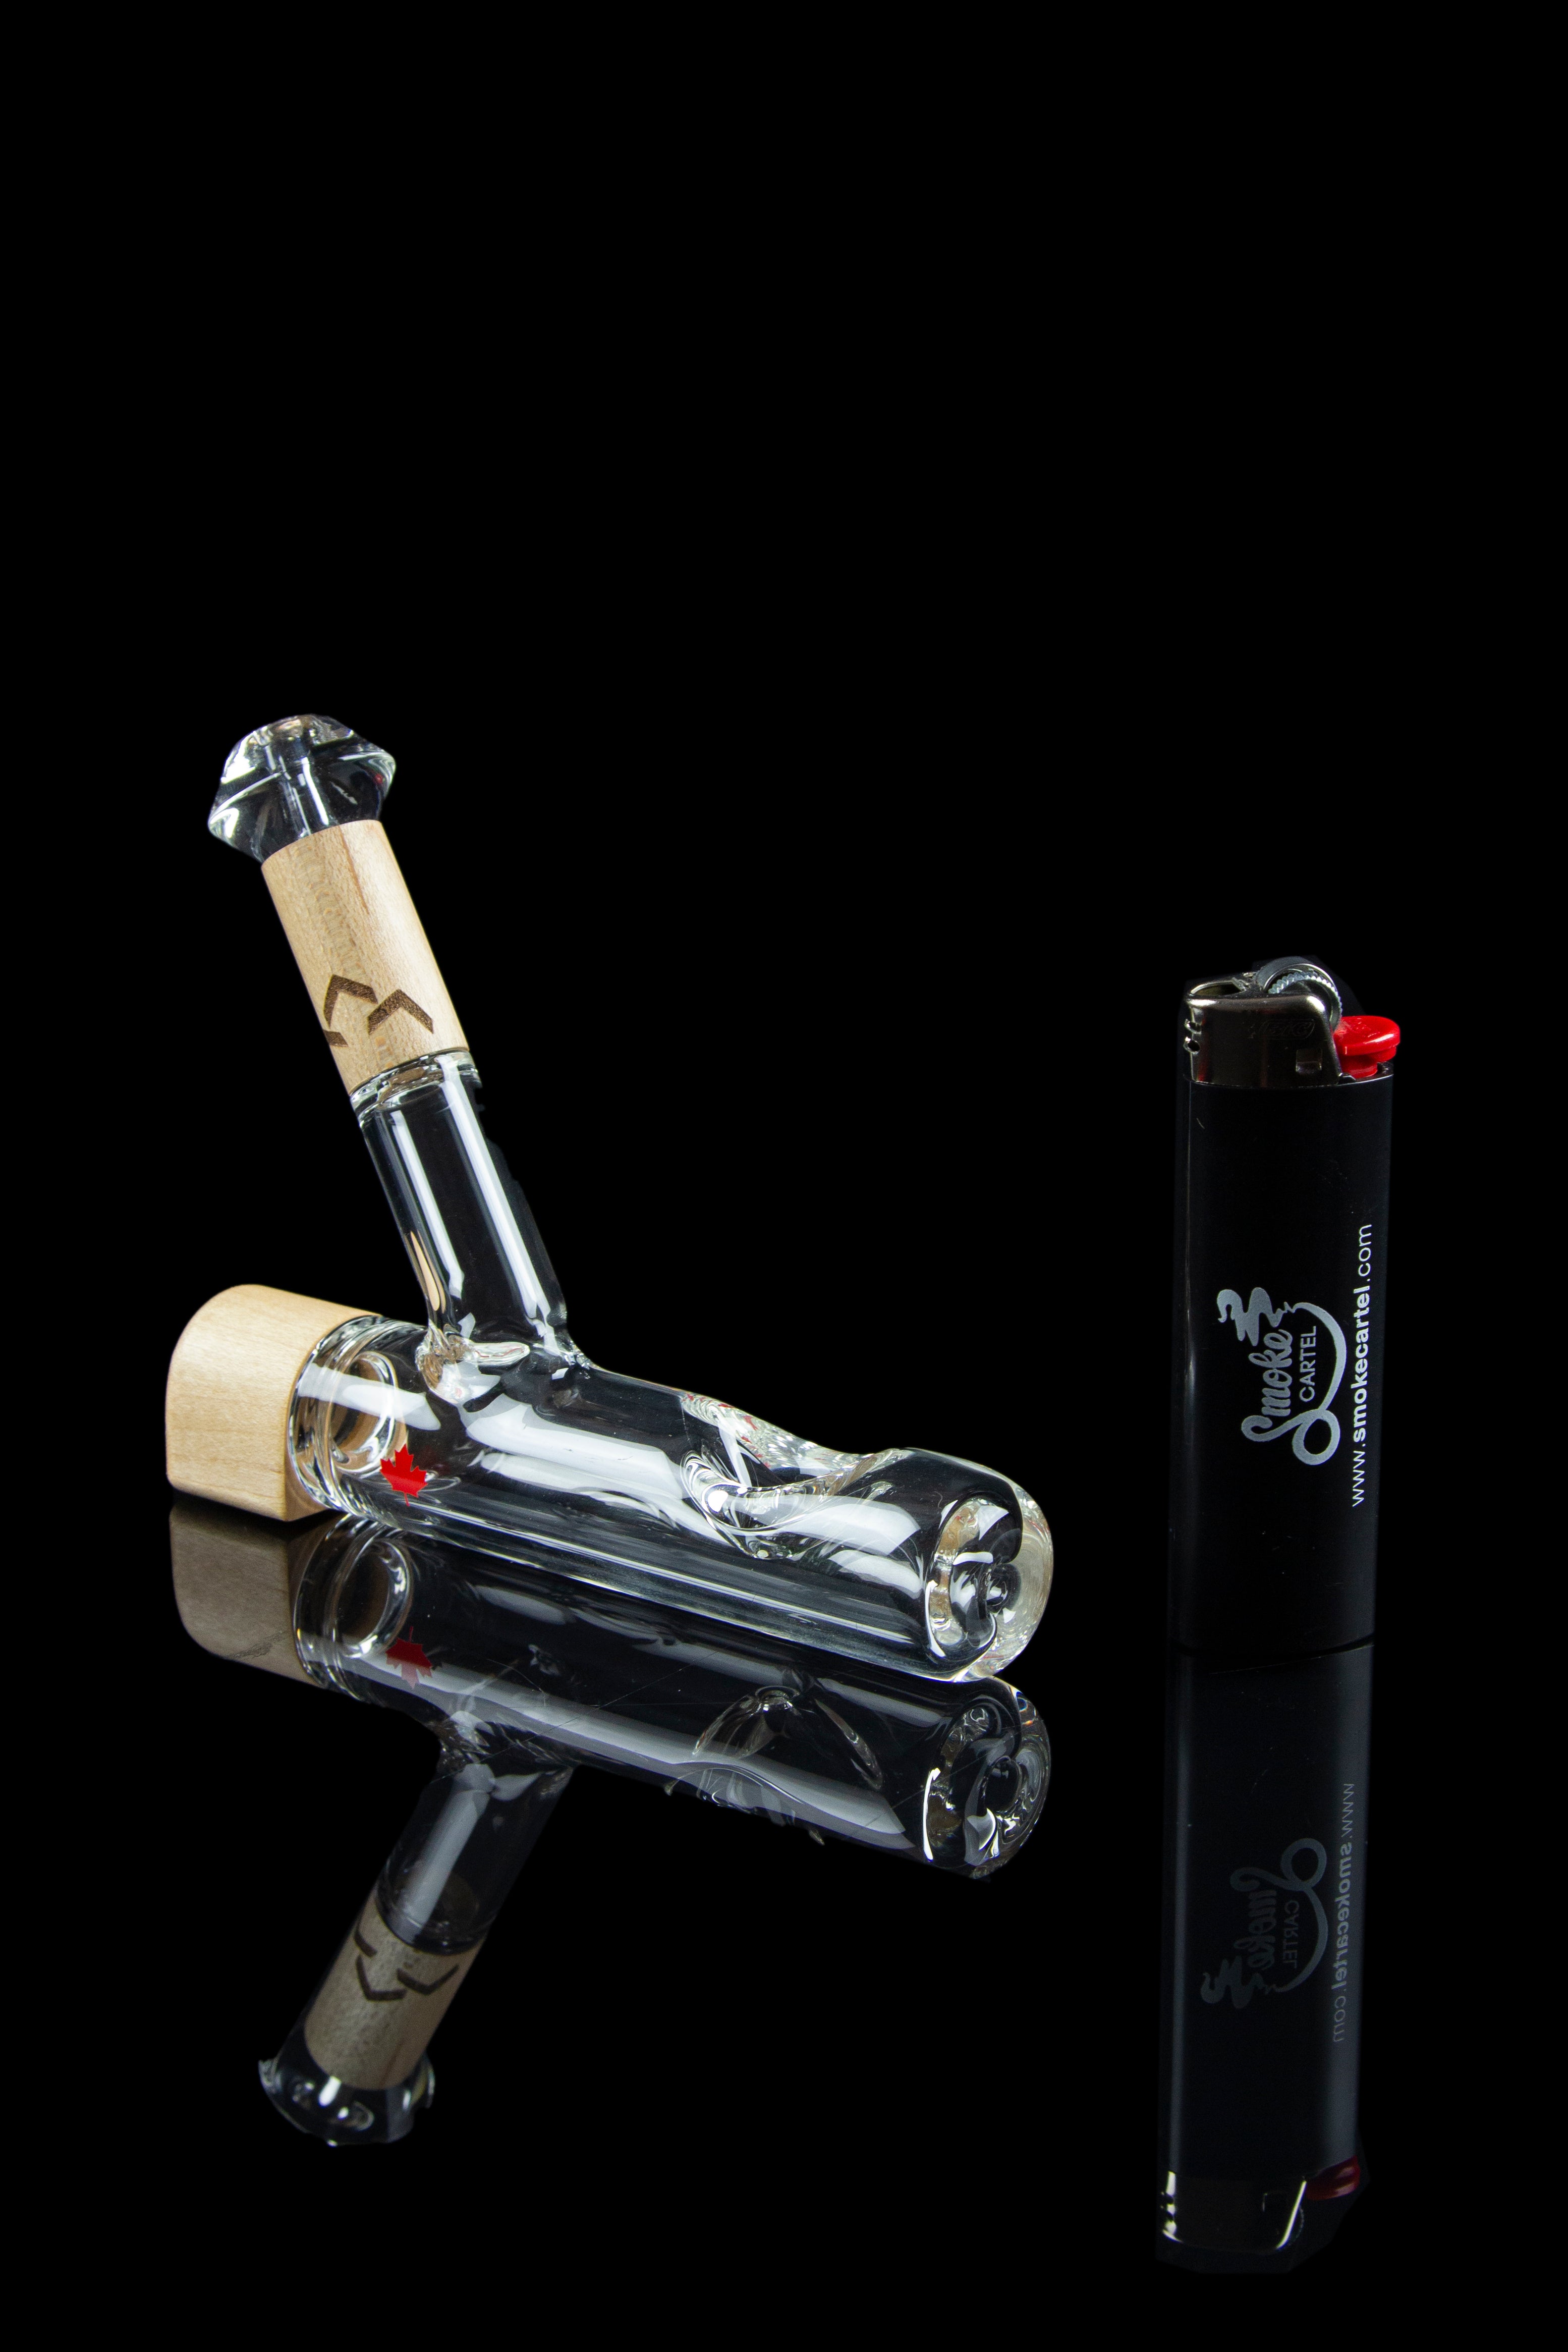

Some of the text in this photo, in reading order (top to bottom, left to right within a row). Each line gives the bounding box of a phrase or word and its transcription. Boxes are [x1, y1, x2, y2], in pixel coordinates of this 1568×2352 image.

[1262, 1020, 1313, 1037] BIC
[1300, 1326, 1316, 1402] CARTEL
[1351, 1224, 1372, 1507] www.smokecartel.com
